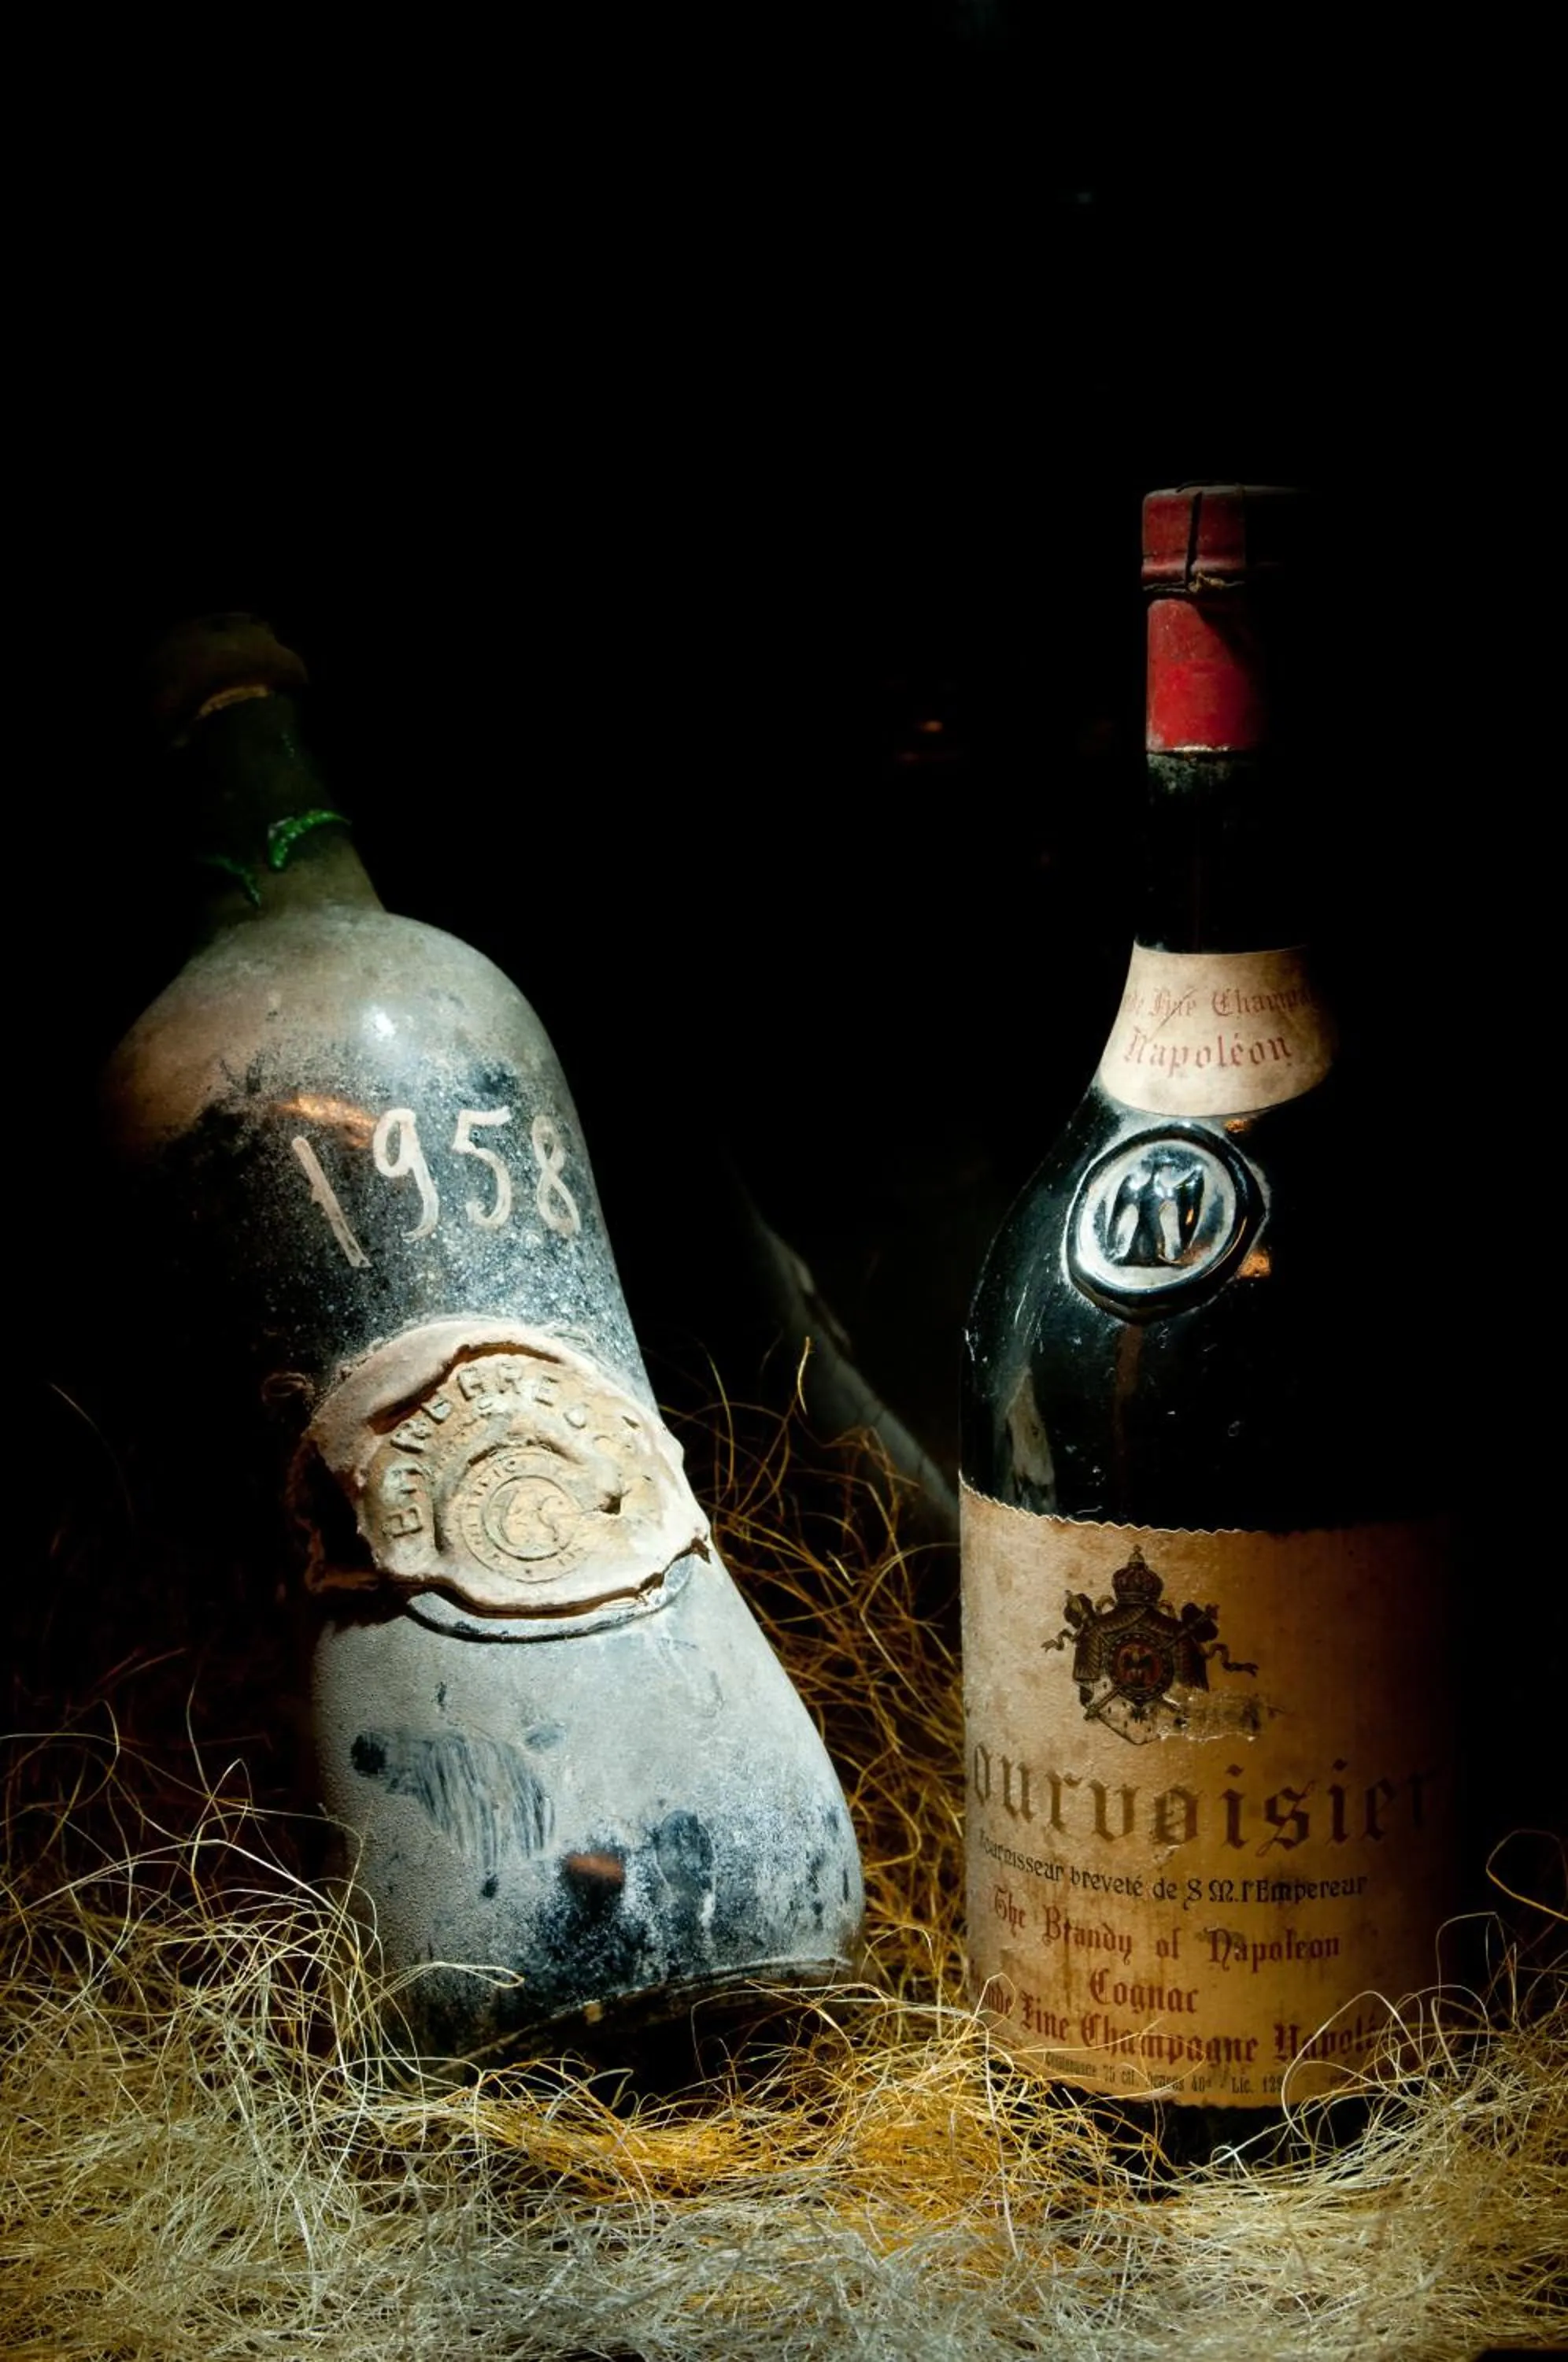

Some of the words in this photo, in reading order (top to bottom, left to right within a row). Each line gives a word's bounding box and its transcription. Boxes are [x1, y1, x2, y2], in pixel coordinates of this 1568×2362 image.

[1125, 1027, 1292, 1078] Napoléon
[292, 1108, 581, 1268] 1958
[1071, 1867, 1143, 1897] breveté
[1153, 1877, 1178, 1900] de
[994, 1886, 1026, 1938] The
[1043, 1904, 1132, 1966] Brandy
[1156, 1927, 1182, 1960] of
[1207, 1928, 1341, 1972] Napoleon
[1089, 1968, 1199, 2014] Cognac
[1021, 1990, 1070, 2042] Fine
[1081, 2013, 1259, 2068] Champagne
